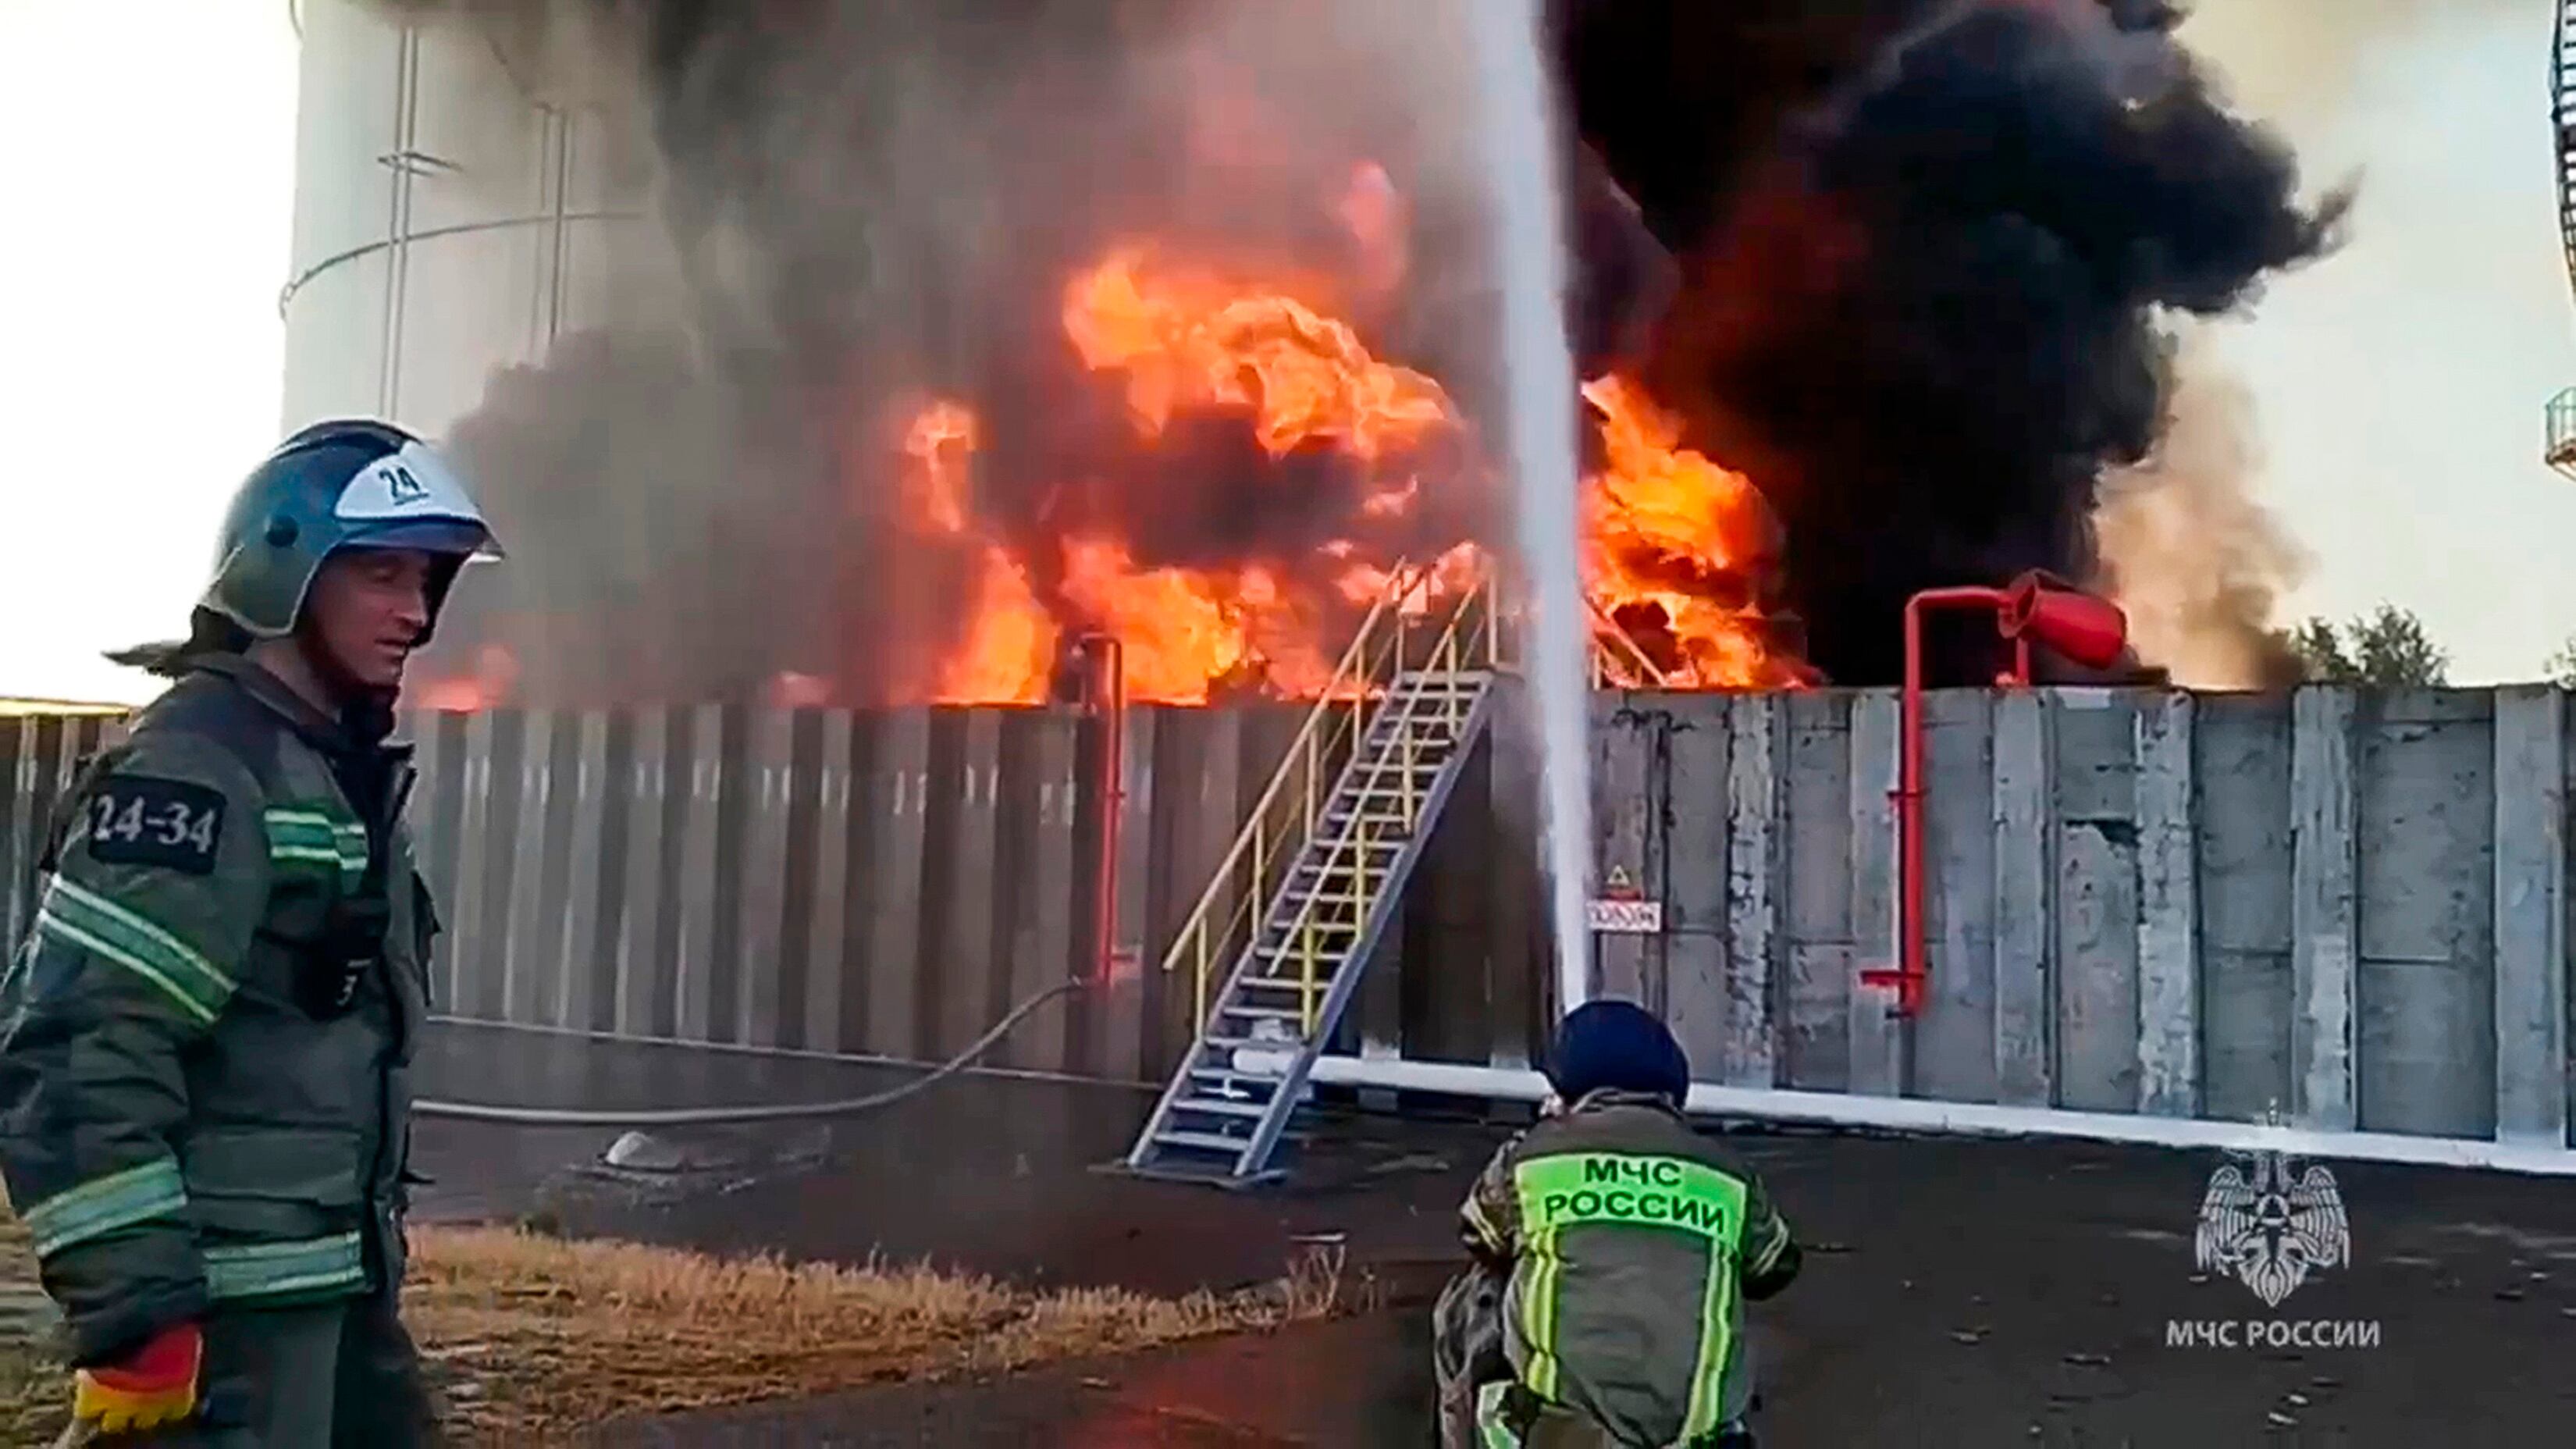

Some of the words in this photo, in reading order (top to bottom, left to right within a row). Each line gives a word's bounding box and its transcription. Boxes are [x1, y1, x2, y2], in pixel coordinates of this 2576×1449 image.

[379, 467, 422, 498] 24
[94, 794, 216, 853] 24-34
[1584, 1159, 1681, 1187] МЧС
[1544, 1191, 1724, 1234] РОССИИ
